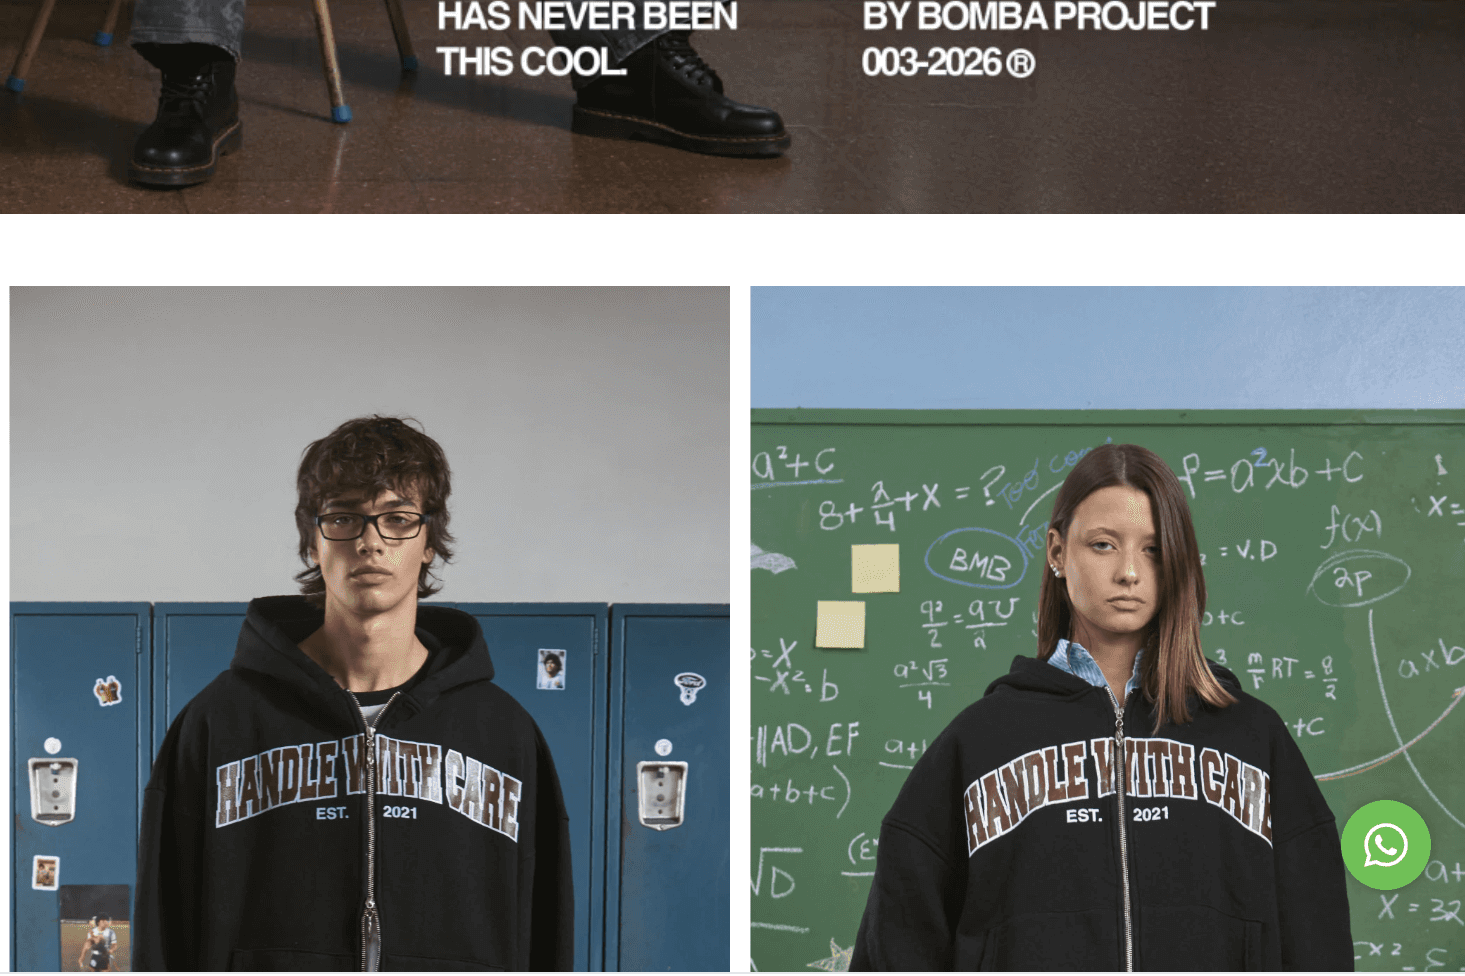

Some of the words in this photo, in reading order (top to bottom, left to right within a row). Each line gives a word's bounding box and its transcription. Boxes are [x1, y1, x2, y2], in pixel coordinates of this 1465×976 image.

[950, 547, 1011, 582] BMB
[216, 740, 339, 829] HANDLE
[342, 733, 442, 804] WITH
[445, 748, 522, 844] CARE
[964, 740, 1089, 858] HANDLE
[1090, 736, 1198, 800] WITH
[316, 806, 349, 820] EST.
[382, 805, 417, 820] 2021
[1066, 808, 1103, 823] EST.
[1132, 805, 1169, 822] 2021
